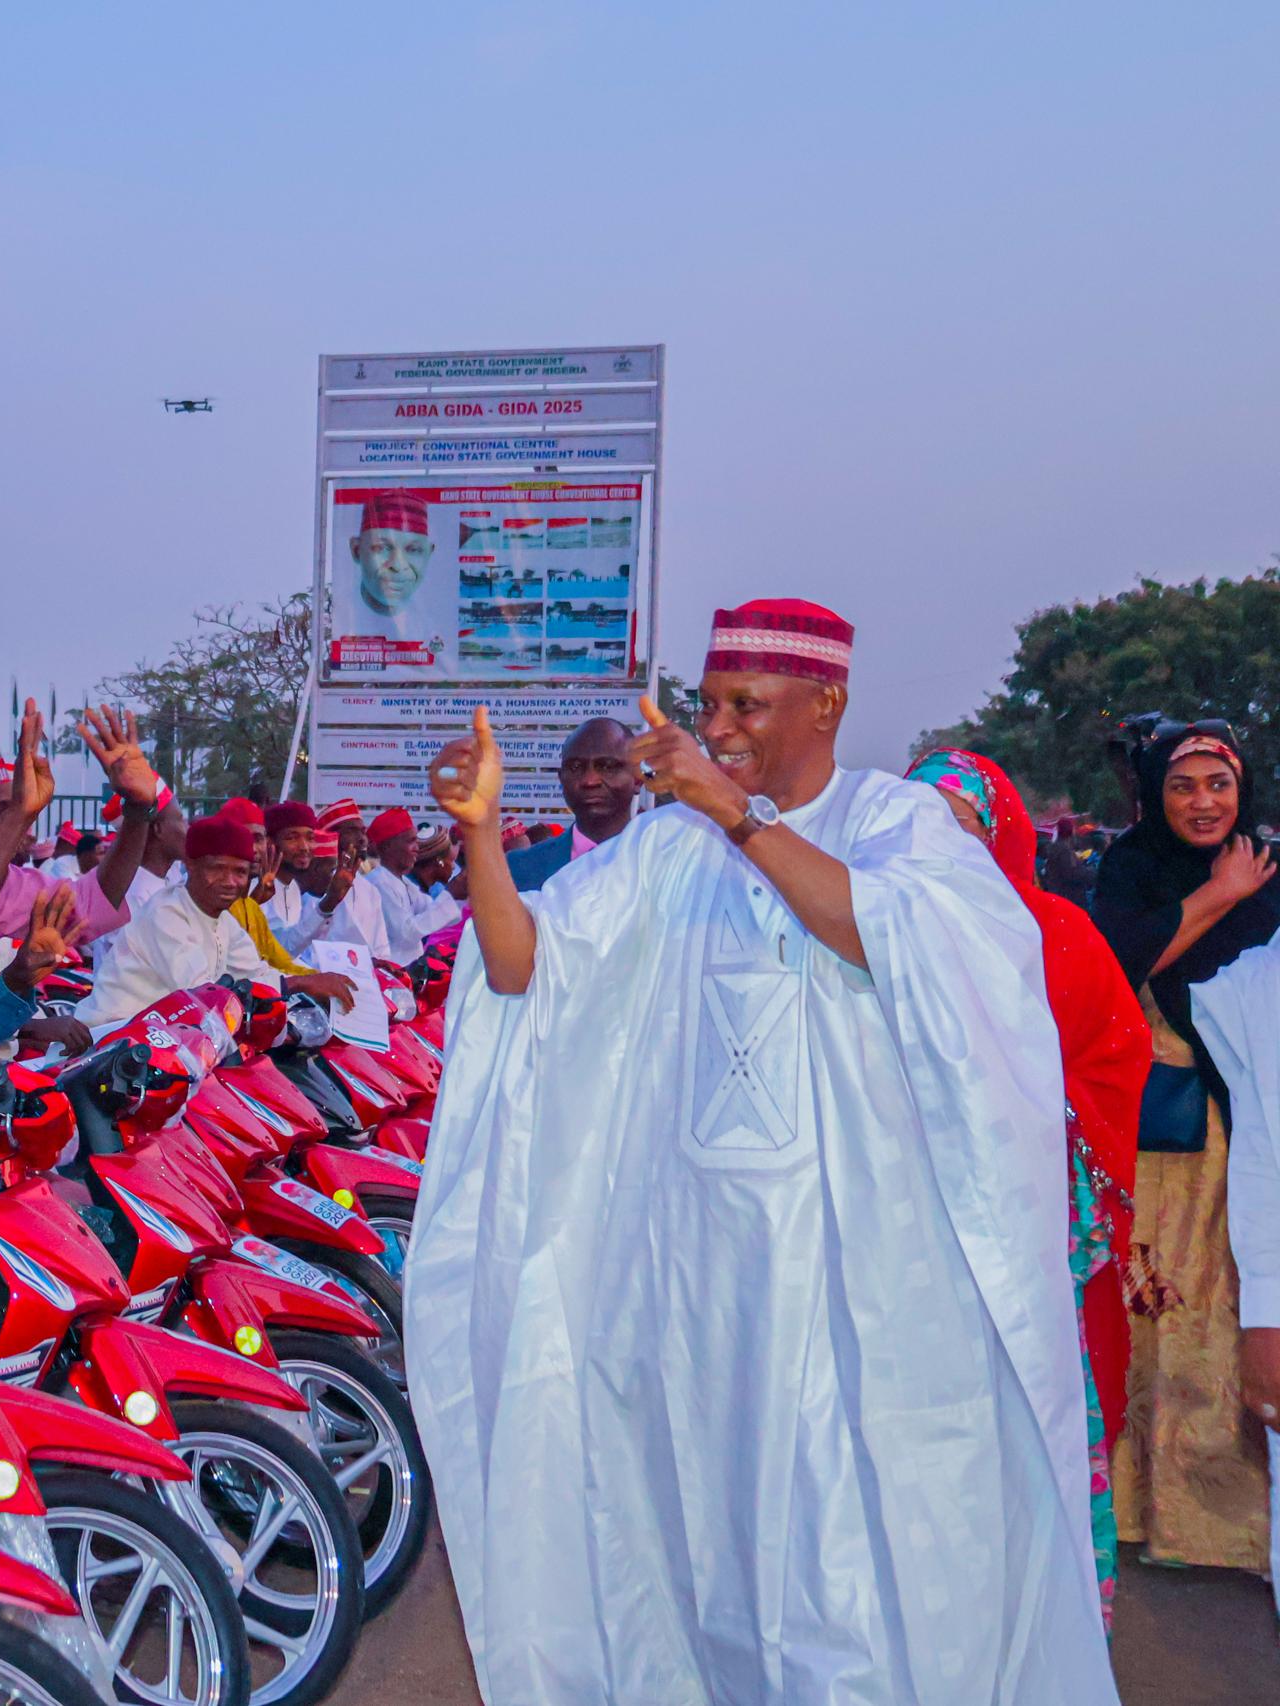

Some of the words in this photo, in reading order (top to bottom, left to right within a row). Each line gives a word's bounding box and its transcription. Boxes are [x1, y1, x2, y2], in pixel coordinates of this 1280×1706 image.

[417, 359, 448, 369] KANO
[451, 358, 485, 368] STATE
[488, 356, 565, 367] GOVERNMENT
[394, 369, 442, 379] FEDERAL
[445, 367, 521, 378] GOVERNMENT
[524, 367, 538, 376] OF
[542, 365, 587, 375] NIGERIA
[395, 403, 439, 417] ABBA
[444, 402, 483, 417] GIDA
[498, 401, 538, 416] GIDA
[543, 399, 582, 414] 2025
[364, 440, 418, 451] PROJECT:
[422, 440, 510, 451] CONVENTIONAL
[513, 439, 559, 450] CENTRE
[359, 453, 417, 463] LOCATION:
[422, 453, 454, 462] KANO
[458, 452, 492, 462] STATE
[496, 450, 574, 461] GOVERNMENT
[577, 448, 617, 458] HOUSE
[460, 490, 481, 501] STATE
[481, 489, 529, 501] GOVERNMENT
[555, 487, 608, 500] CONVENTIONAL
[609, 487, 637, 499] CENTER
[341, 651, 384, 662] EXECUTIVE
[385, 651, 428, 662] GOVERNOR
[381, 698, 431, 706] MINISTRY
[452, 699, 491, 707] WORKS
[494, 699, 502, 707] &
[506, 699, 556, 707] HOUSING
[559, 699, 591, 707] KANO
[594, 698, 629, 707] STATE
[496, 741, 534, 750] FICIENT
[537, 742, 565, 751] SERV
